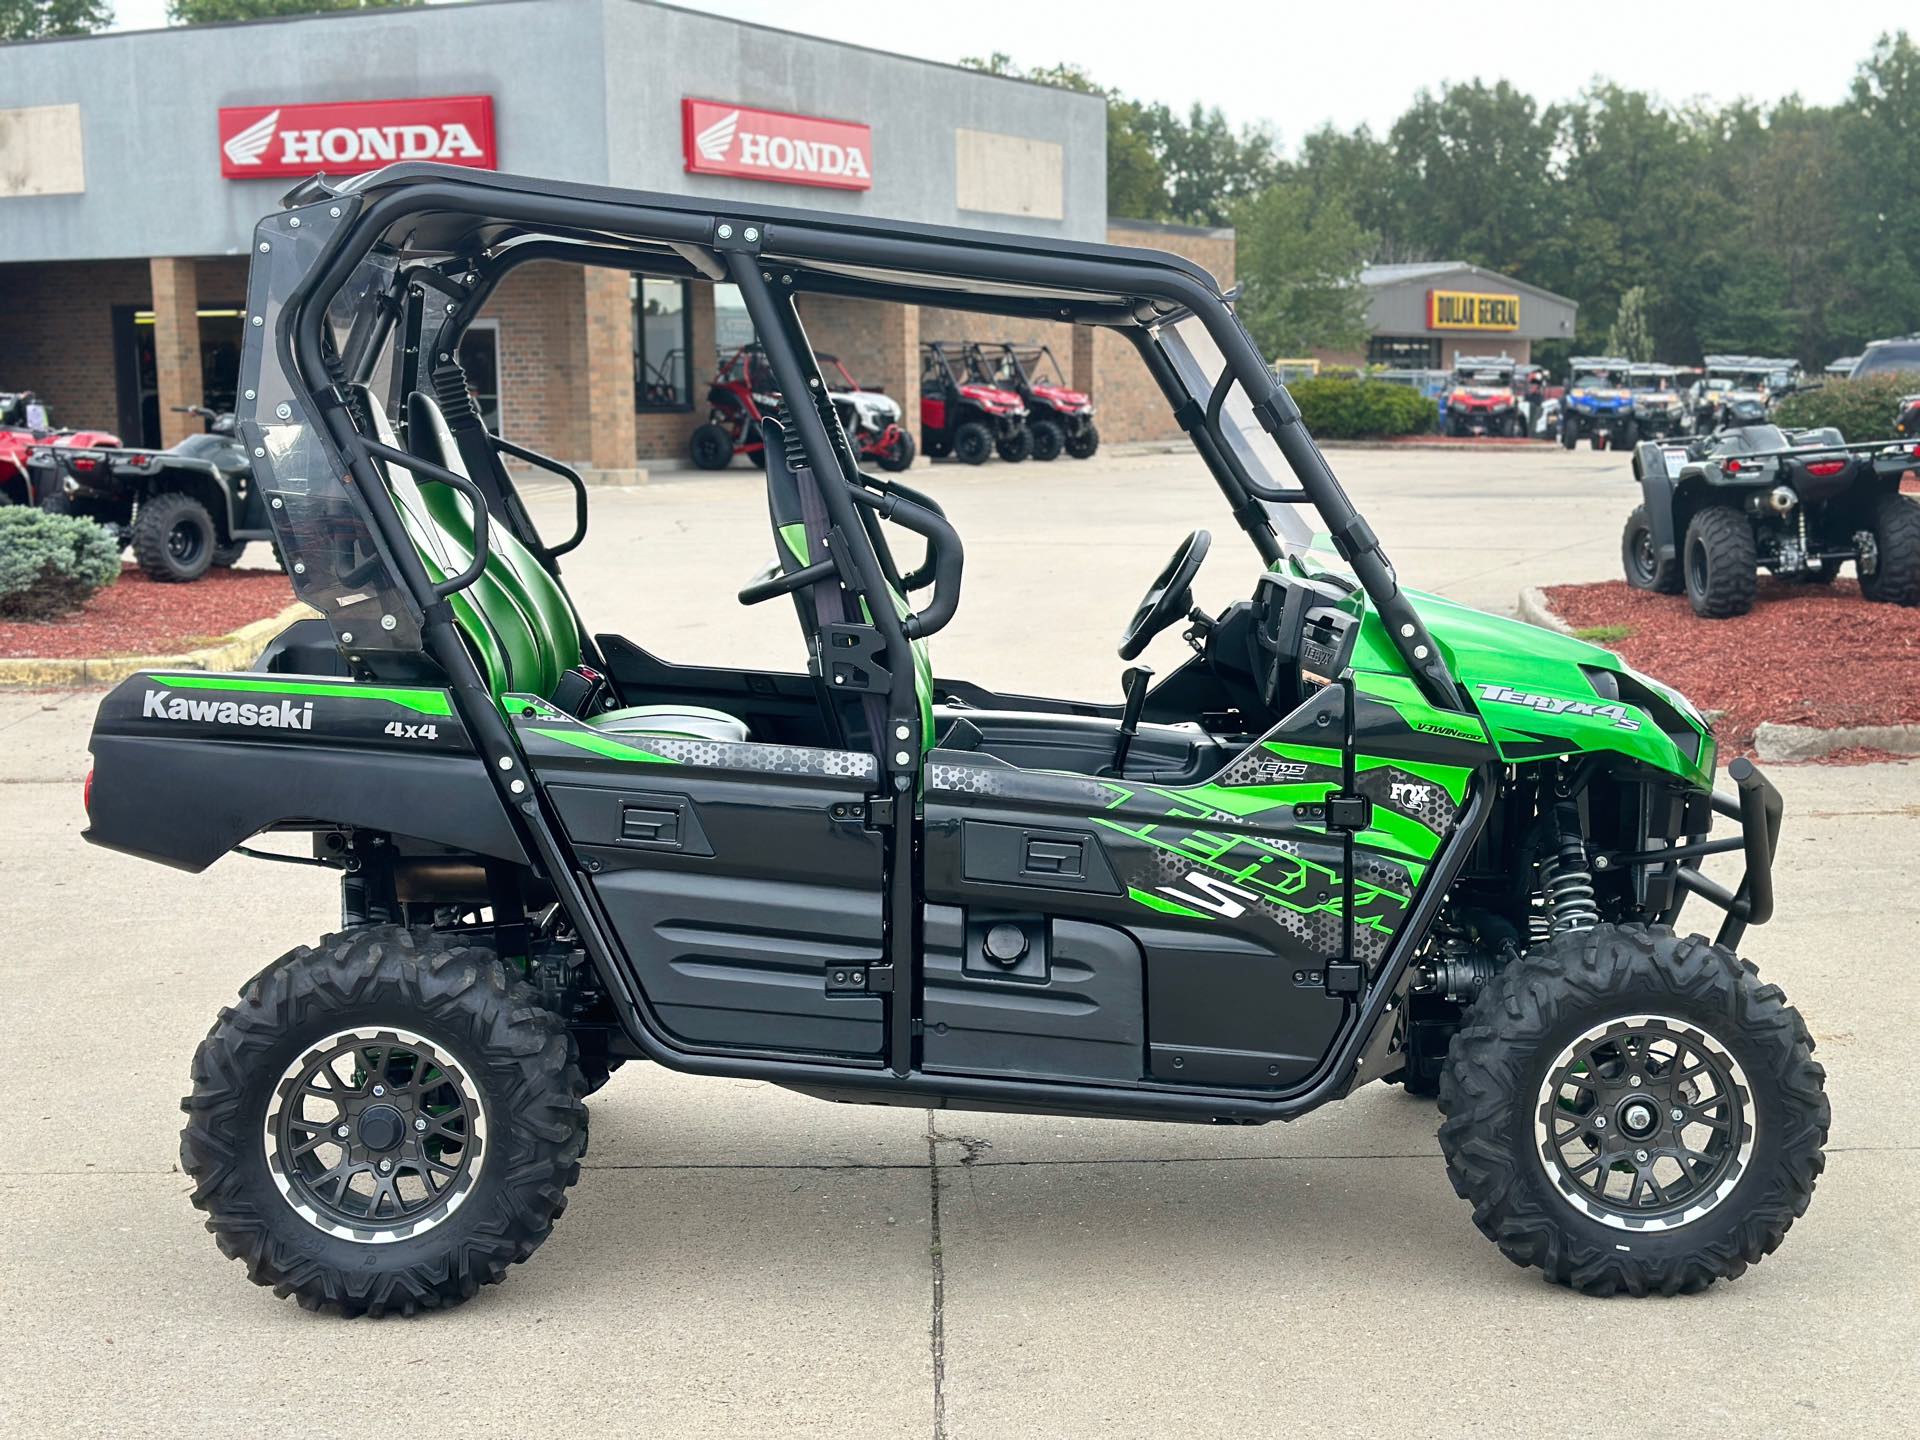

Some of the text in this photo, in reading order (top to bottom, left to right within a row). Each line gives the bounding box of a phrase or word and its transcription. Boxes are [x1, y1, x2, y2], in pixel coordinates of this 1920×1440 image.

[280, 123, 483, 164] HONDA
[738, 131, 870, 179] HONDA
[1437, 296, 1518, 325] DOLLAR GENERAL
[142, 689, 439, 740] Kawasaki 4x4
[1390, 783, 1431, 811] FOX
